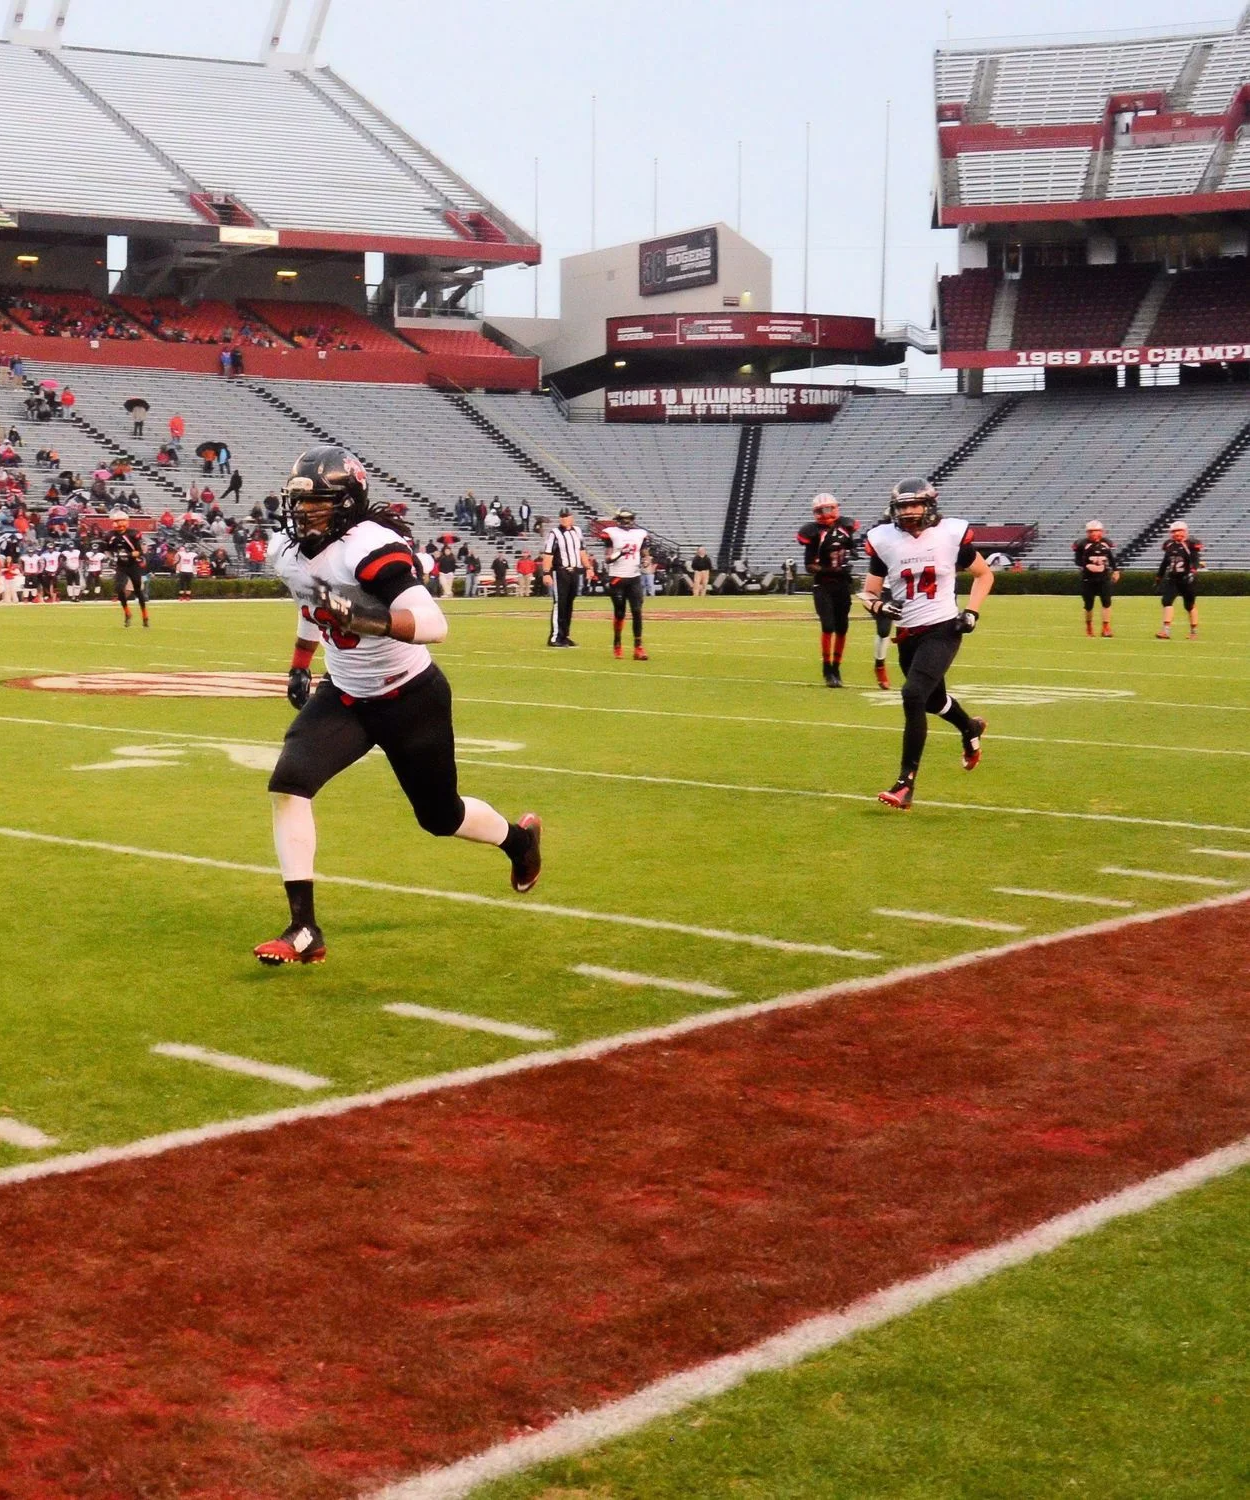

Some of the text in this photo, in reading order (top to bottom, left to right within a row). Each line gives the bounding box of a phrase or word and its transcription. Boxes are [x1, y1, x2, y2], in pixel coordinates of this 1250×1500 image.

[665, 246, 711, 267] ROGERS
[1016, 351, 1082, 366] 1969
[1088, 349, 1140, 364] ACC
[607, 387, 851, 407] WELCOME TO WILLIAMS-BRICE STADI
[665, 404, 693, 415] HOME
[694, 404, 709, 415] OF
[710, 404, 729, 415] THE
[900, 565, 937, 600] 14
